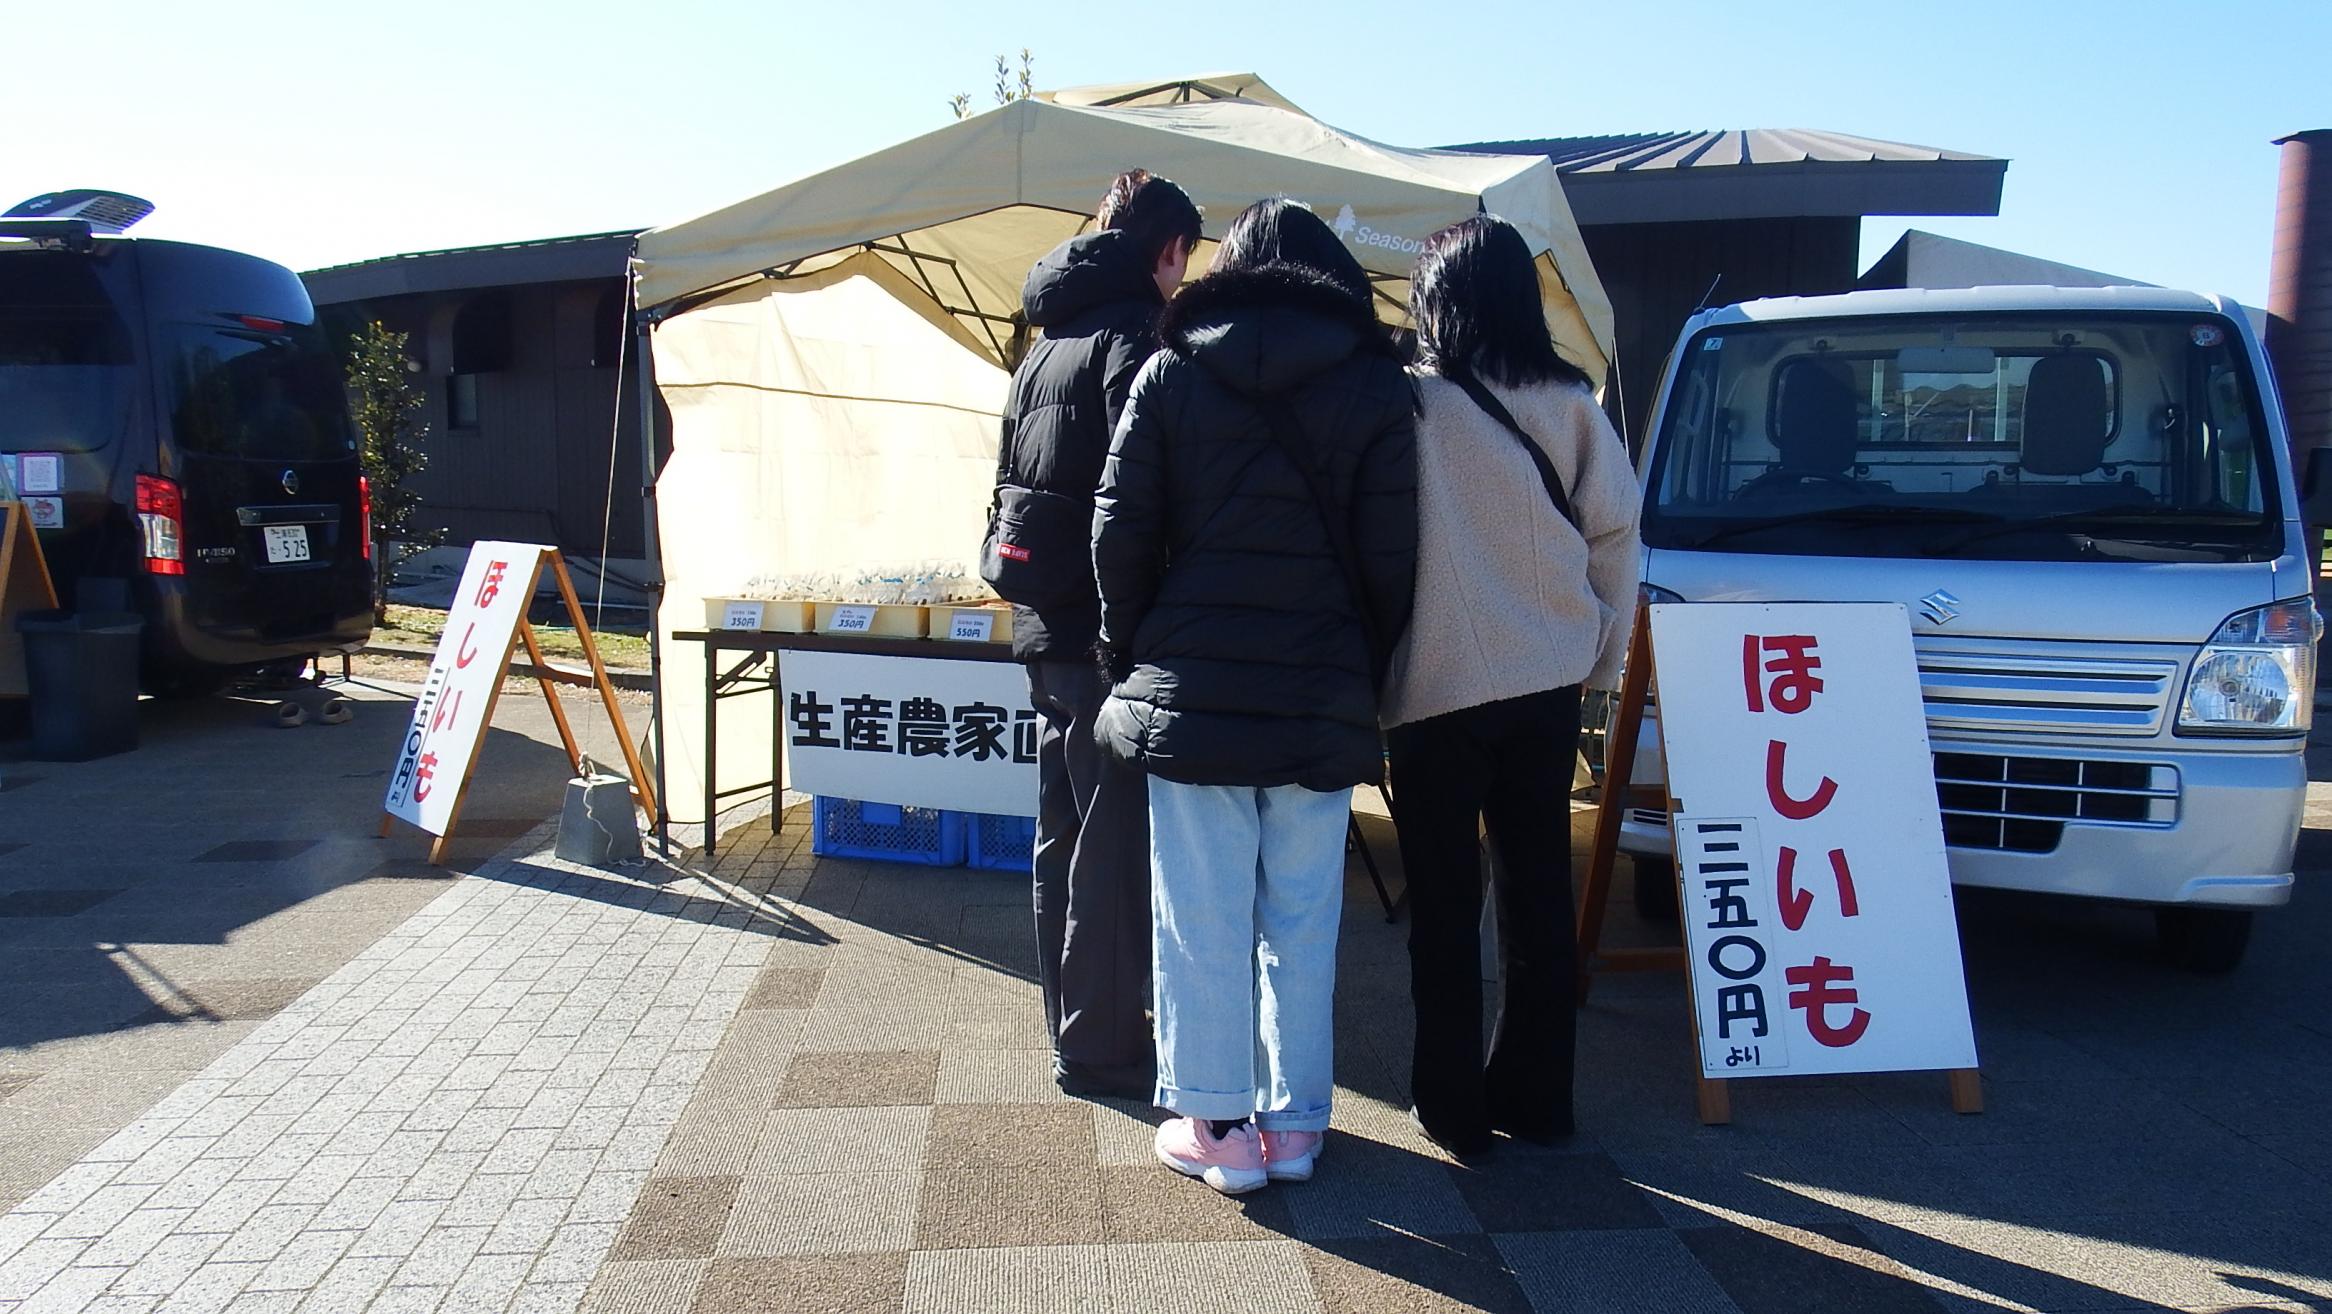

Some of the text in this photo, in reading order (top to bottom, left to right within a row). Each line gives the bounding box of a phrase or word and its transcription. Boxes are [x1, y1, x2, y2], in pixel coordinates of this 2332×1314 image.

[731, 617, 756, 627] 350円
[837, 619, 865, 629] 350円
[956, 628, 981, 638] 550円
[413, 560, 508, 803] ほしいも
[1743, 634, 1871, 1048] ほしいも
